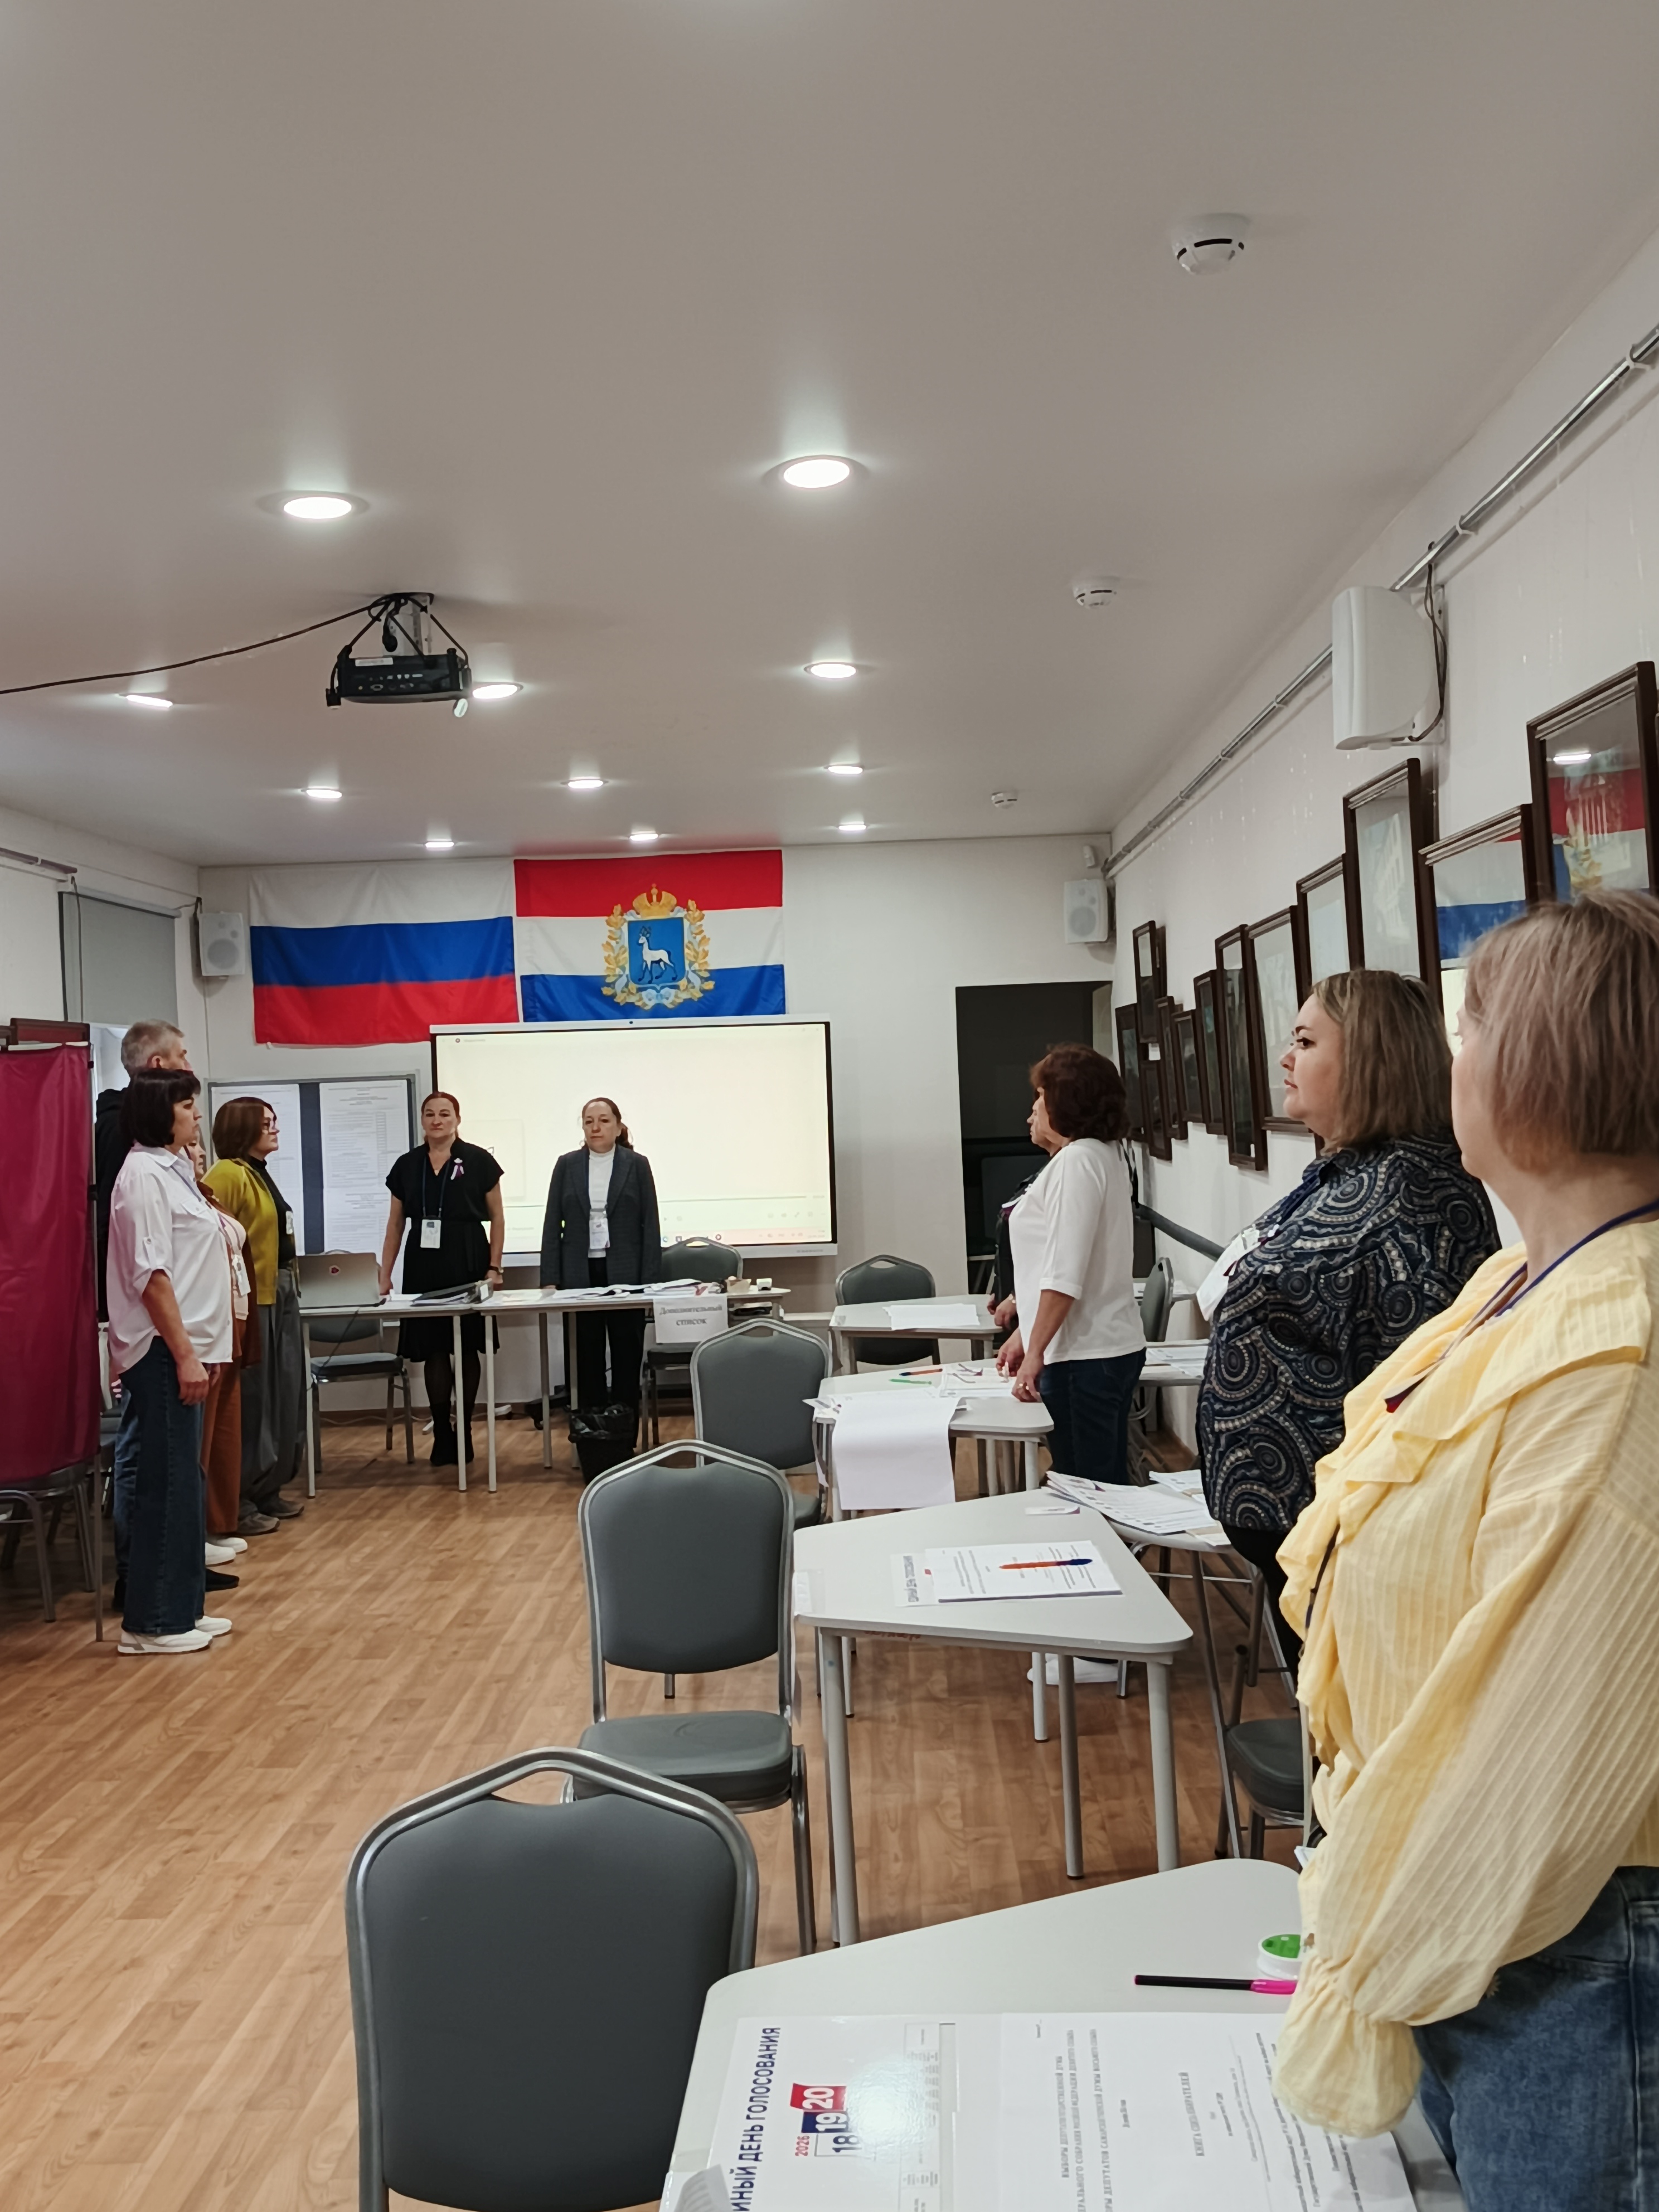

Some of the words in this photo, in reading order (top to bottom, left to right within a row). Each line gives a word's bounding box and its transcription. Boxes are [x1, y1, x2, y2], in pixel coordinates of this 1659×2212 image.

[745, 2027, 781, 2120] ГОЛОСОВАНИЯ
[802, 2088, 835, 2109] 20
[816, 2113, 847, 2132] 19
[738, 2124, 764, 2162] ДЕНЬ
[832, 2135, 862, 2152] 18
[729, 2166, 757, 2212] ИНЫЙ
